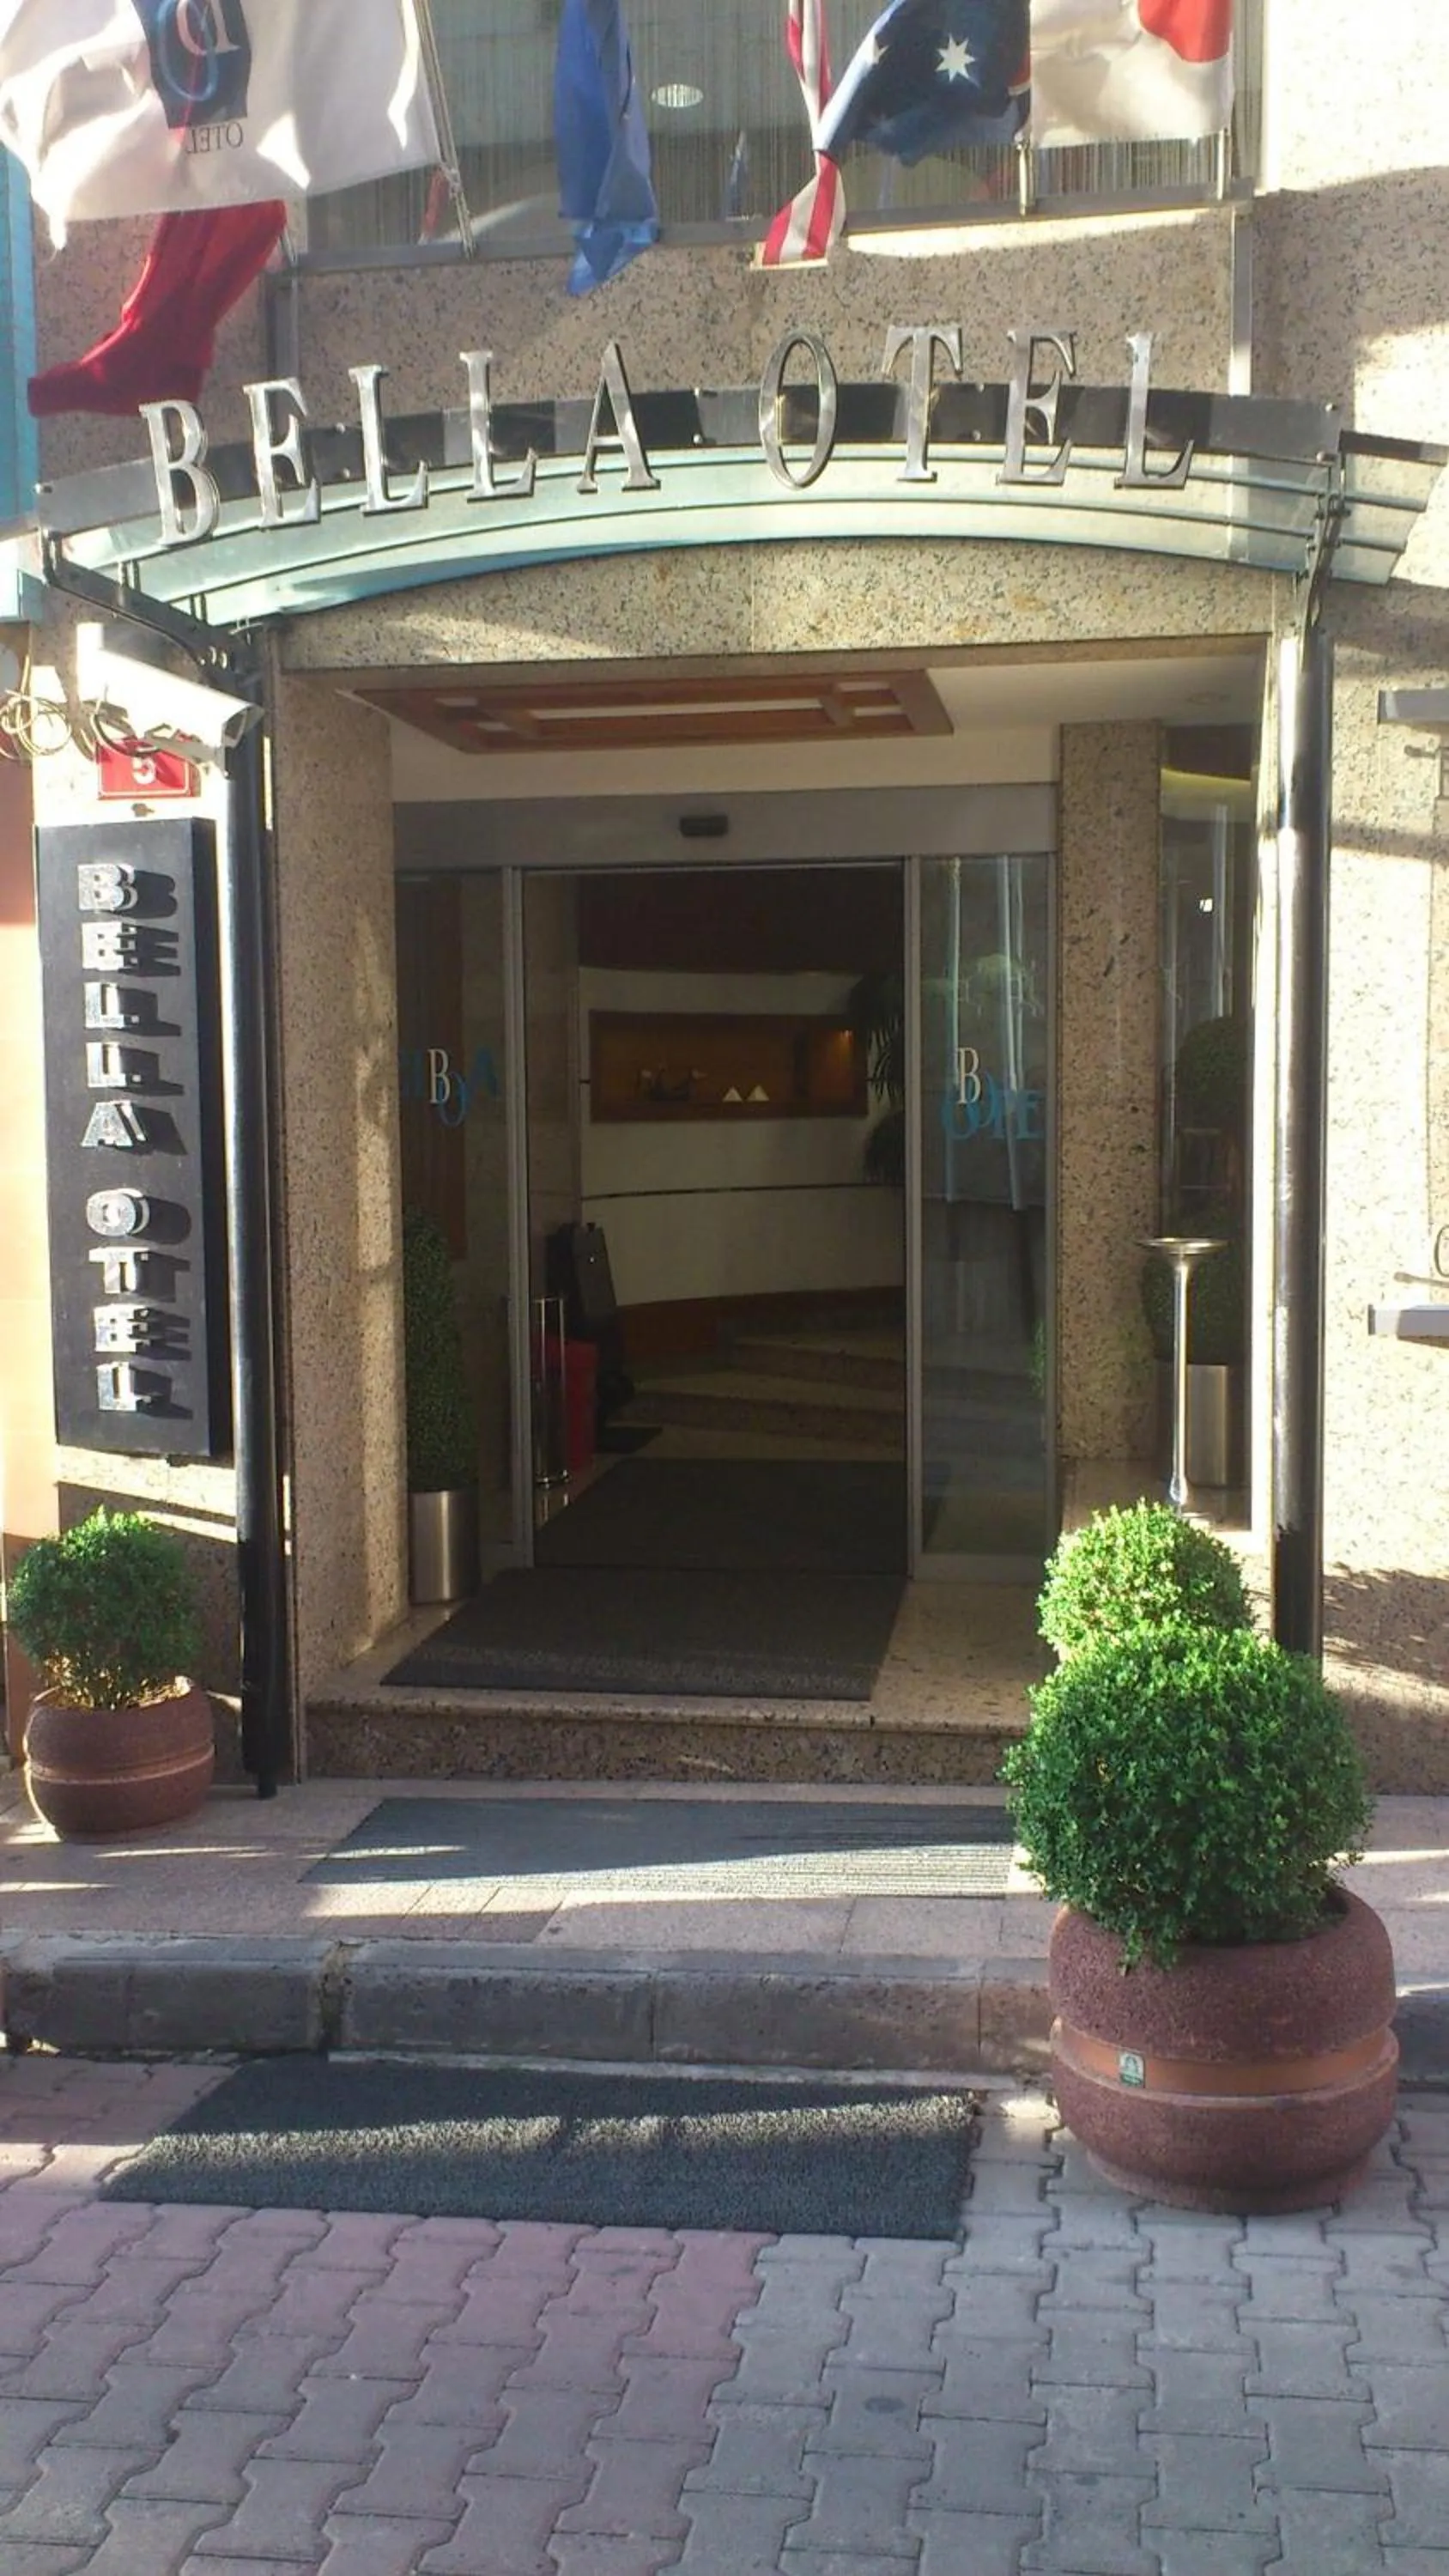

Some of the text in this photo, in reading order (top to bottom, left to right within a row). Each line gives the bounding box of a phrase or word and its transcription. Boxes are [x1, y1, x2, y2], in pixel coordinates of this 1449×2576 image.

[139, 324, 1194, 549] BELLA OTEL
[78, 862, 151, 1411] BELLA OTEL
